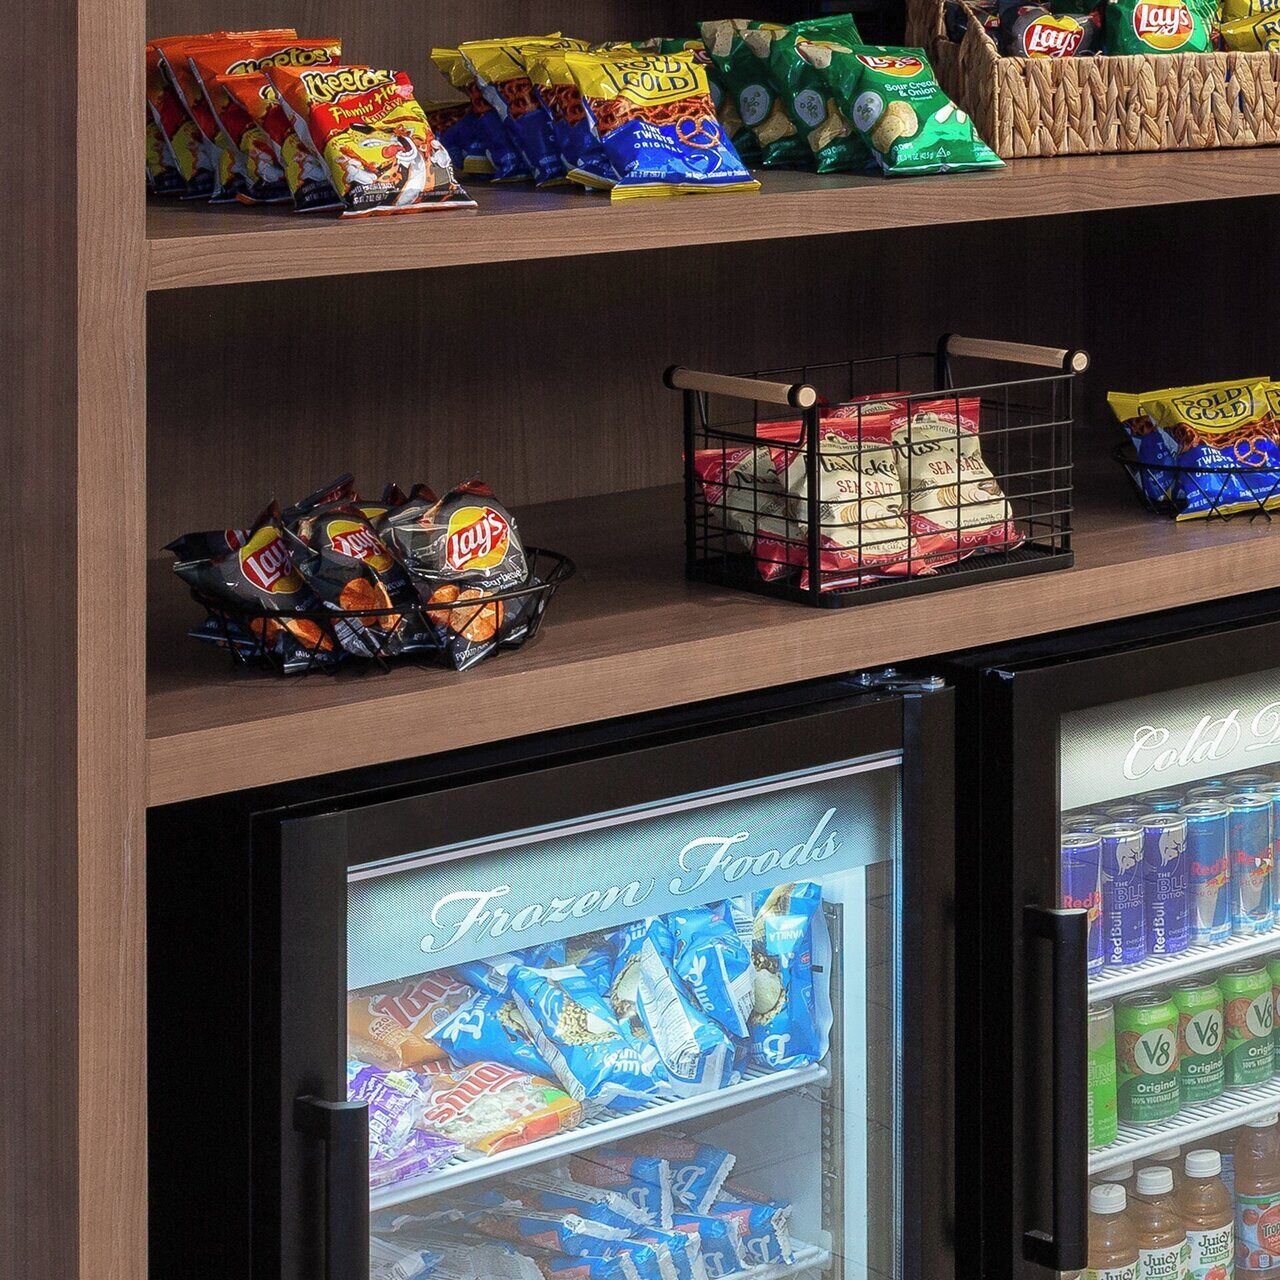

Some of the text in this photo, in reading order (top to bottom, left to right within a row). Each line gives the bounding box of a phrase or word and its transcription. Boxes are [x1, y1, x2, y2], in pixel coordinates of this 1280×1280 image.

[1138, 4, 1190, 36] Lay's
[1029, 25, 1081, 57] Lay's
[616, 58, 682, 74] ROLD
[624, 72, 690, 92] GOLD
[885, 82, 907, 92] Sour
[898, 86, 937, 97] & Onion
[330, 99, 374, 123] Flamin'
[634, 130, 675, 145] TWISTS
[640, 122, 661, 136] TINY
[633, 143, 683, 154] ORIGINAL
[1183, 387, 1243, 408] ROLD
[1185, 400, 1248, 421] GOLD
[1197, 454, 1233, 466] TWISTS
[1201, 447, 1222, 456] TINY
[929, 454, 984, 476] SEA SALT
[837, 480, 893, 495] SEA SALT
[332, 529, 381, 559] Lay's
[450, 512, 506, 568] Lay's
[246, 540, 294, 588] Lay
[482, 569, 523, 587] Barbecue
[1123, 708, 1241, 781] Cold
[420, 808, 842, 954] Frozen Foods
[768, 929, 805, 942] VANILLA
[1253, 995, 1272, 1029] V8
[1193, 1013, 1219, 1047] V8
[1141, 1033, 1170, 1067] V8
[1137, 1077, 1177, 1094] Original
[1198, 1231, 1231, 1248] Juicy
[1200, 1243, 1229, 1257] Juice
[1143, 1251, 1179, 1268] Juicy
[1145, 1264, 1177, 1276] Juice
